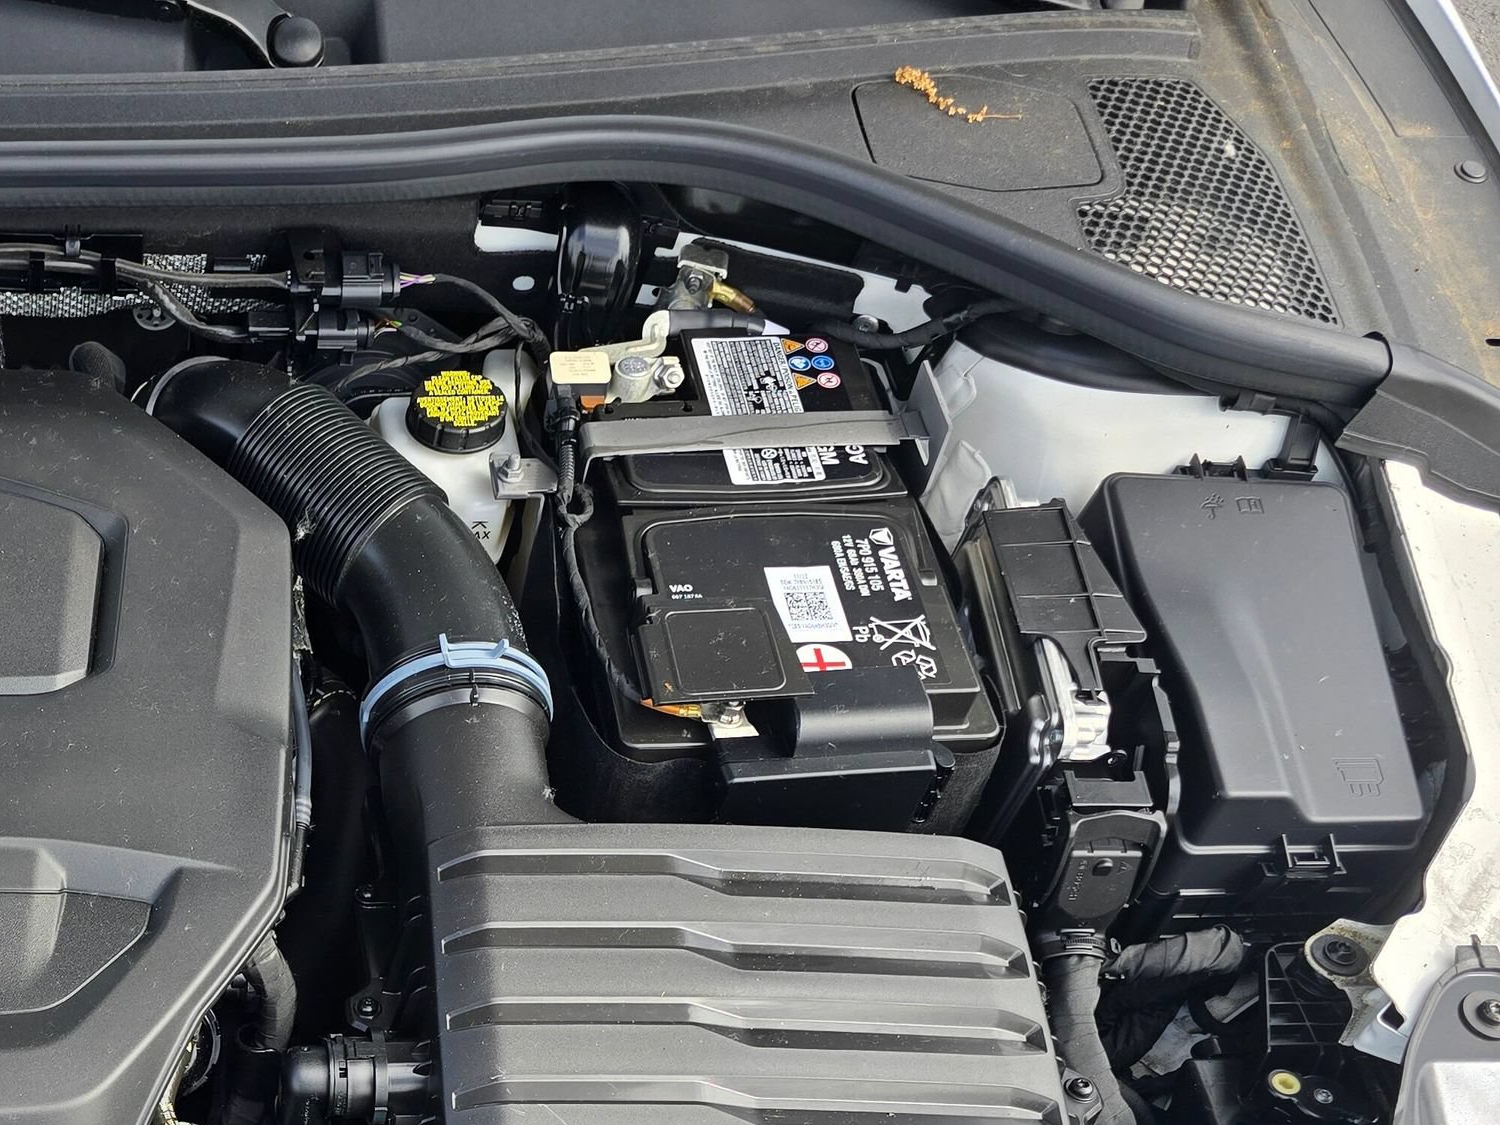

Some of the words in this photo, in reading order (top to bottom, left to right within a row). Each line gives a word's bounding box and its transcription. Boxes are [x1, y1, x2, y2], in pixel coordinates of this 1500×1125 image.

[845, 445, 868, 464] AG
[842, 535, 854, 547] 12V
[856, 538, 872, 556] 7P0
[861, 557, 878, 573] 915
[878, 546, 912, 601] VARTA
[868, 575, 884, 591] 105
[853, 626, 871, 642] Pb
